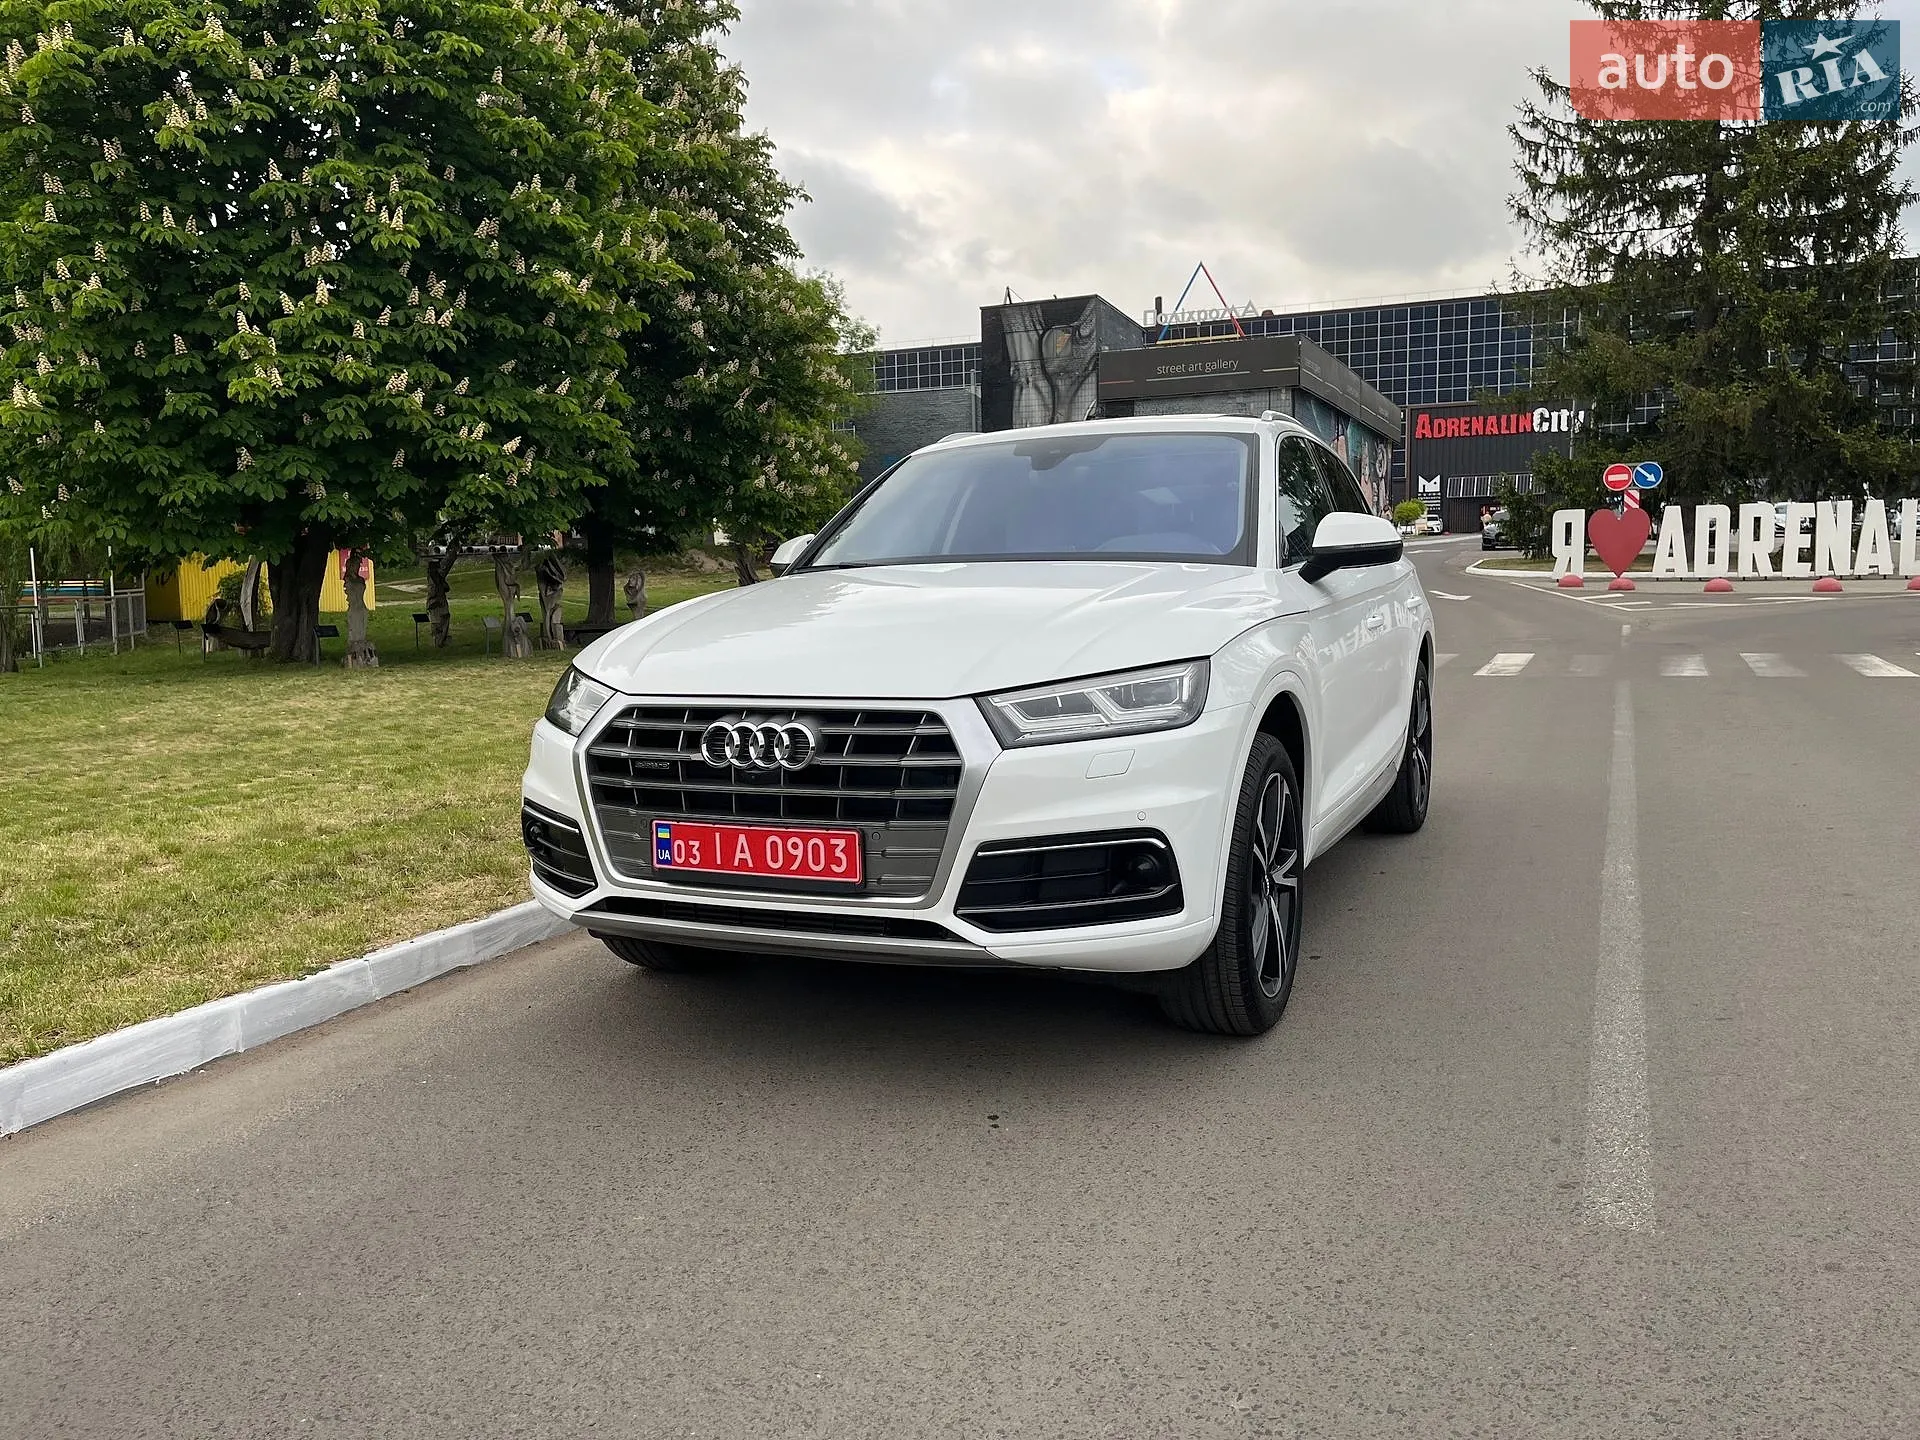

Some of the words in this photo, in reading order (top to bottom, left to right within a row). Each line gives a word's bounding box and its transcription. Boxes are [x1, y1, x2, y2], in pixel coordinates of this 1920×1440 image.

[1157, 364, 1186, 375] street
[1188, 363, 1203, 372] art
[1205, 358, 1239, 371] gallery
[658, 849, 671, 861] UA
[673, 840, 701, 865] 03
[765, 835, 849, 873] 0903
